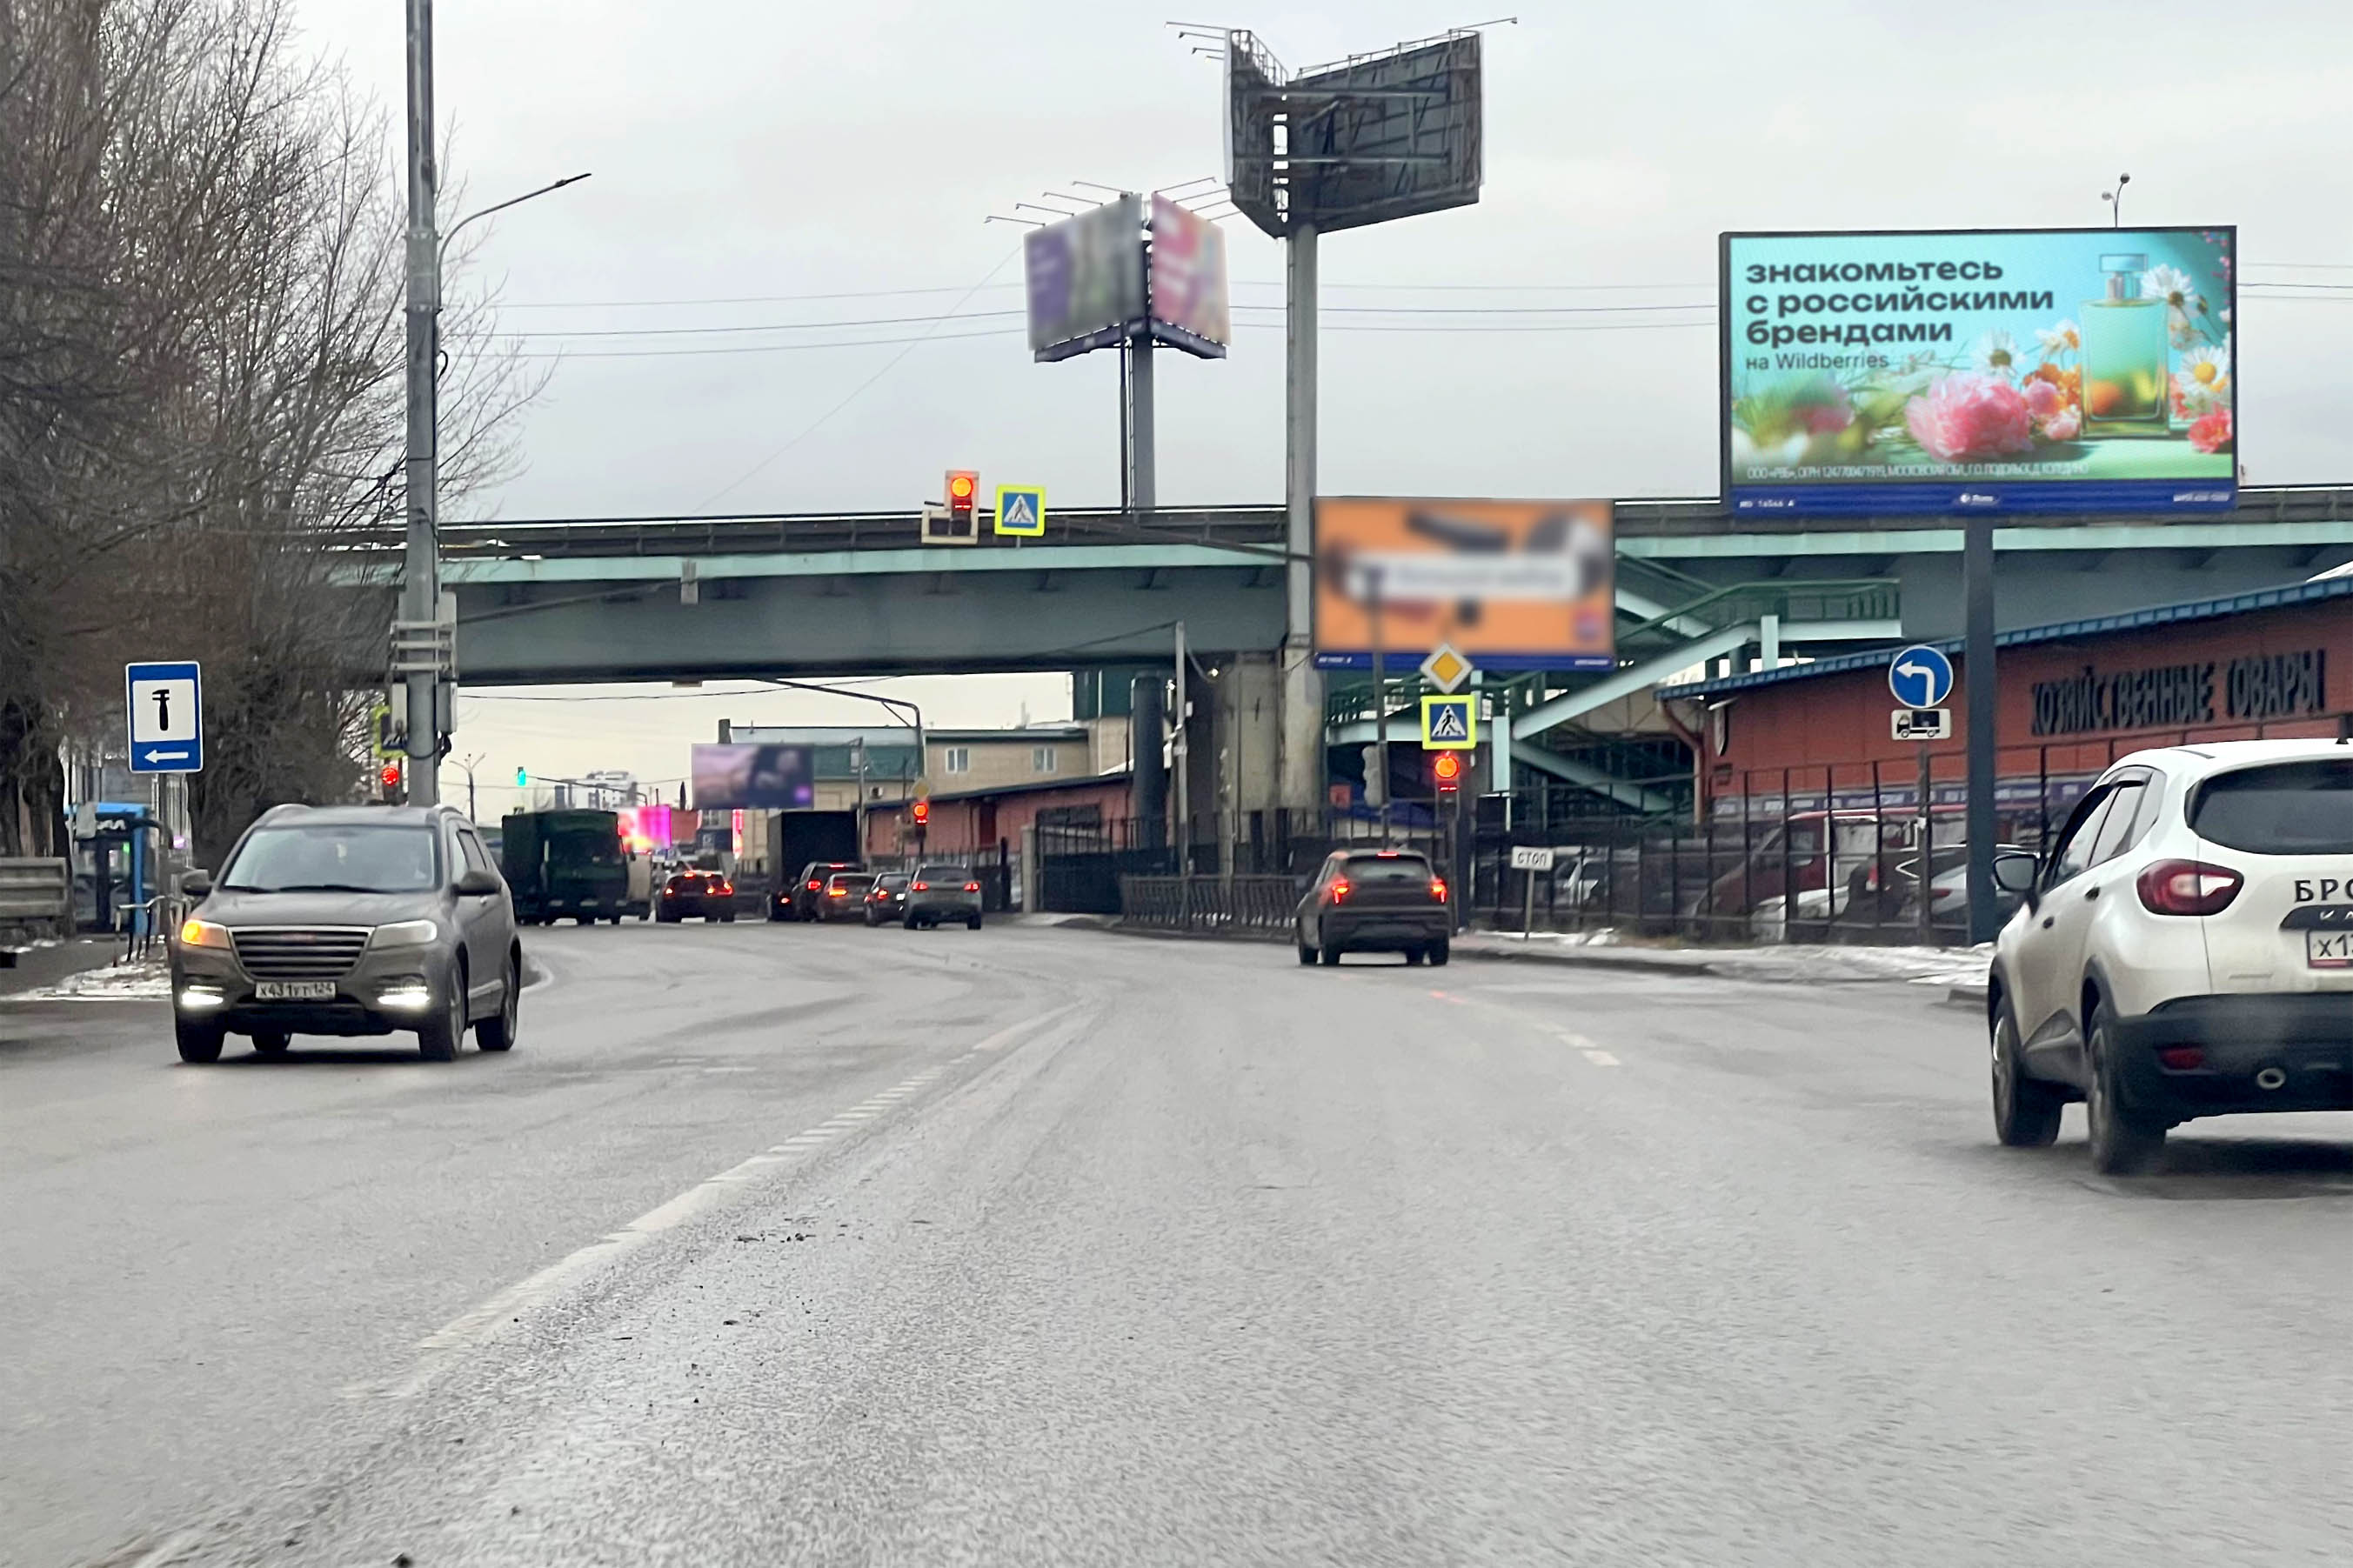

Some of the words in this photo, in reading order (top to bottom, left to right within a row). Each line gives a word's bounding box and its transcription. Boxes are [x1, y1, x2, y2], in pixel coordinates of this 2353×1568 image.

[1746, 260, 2003, 284] знакомьтесь
[1746, 294, 1768, 314] с
[1778, 285, 2054, 318] российскими
[1746, 319, 1951, 349] брендами
[1746, 357, 1768, 370] на
[1775, 351, 1889, 370] Wildberries
[1517, 851, 1547, 867] СТОП
[2317, 933, 2353, 957] Х1
